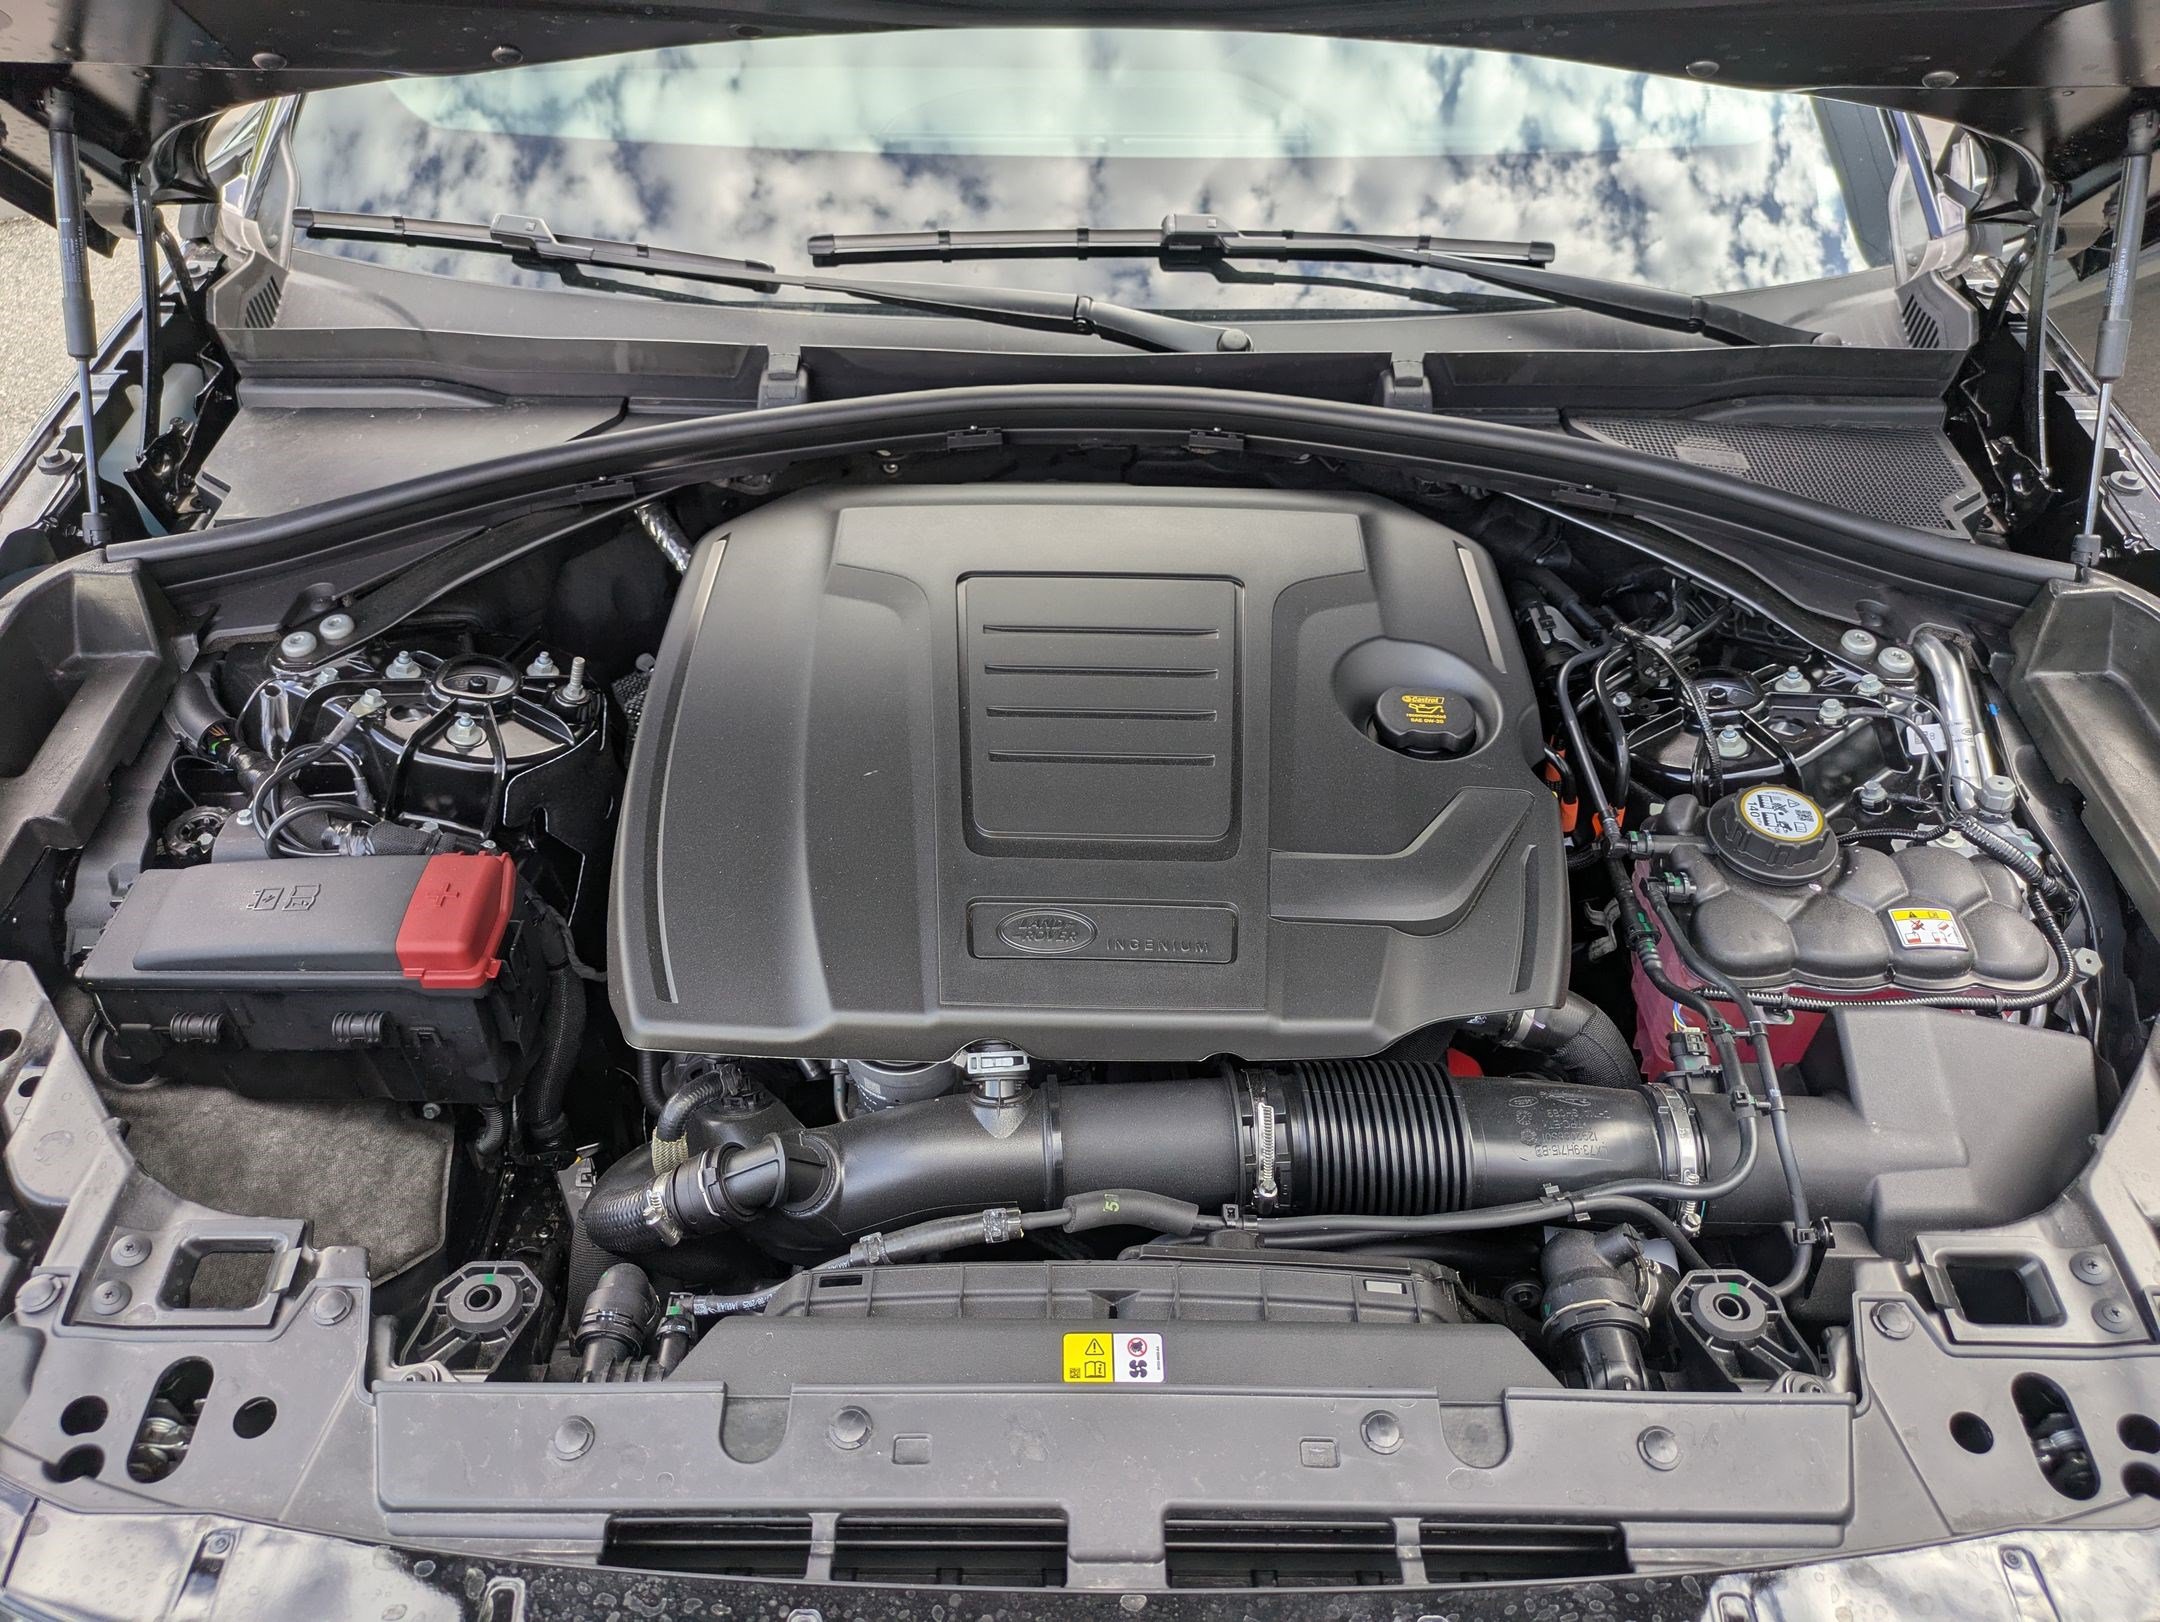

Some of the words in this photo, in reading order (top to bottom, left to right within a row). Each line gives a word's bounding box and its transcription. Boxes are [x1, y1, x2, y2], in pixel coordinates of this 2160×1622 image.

[1412, 696, 1438, 704] Castrol
[1748, 802, 1760, 817] 140
[1018, 918, 1064, 930] LAND
[1021, 930, 1079, 943] ROVER
[1105, 938, 1210, 954] INGENIUM
